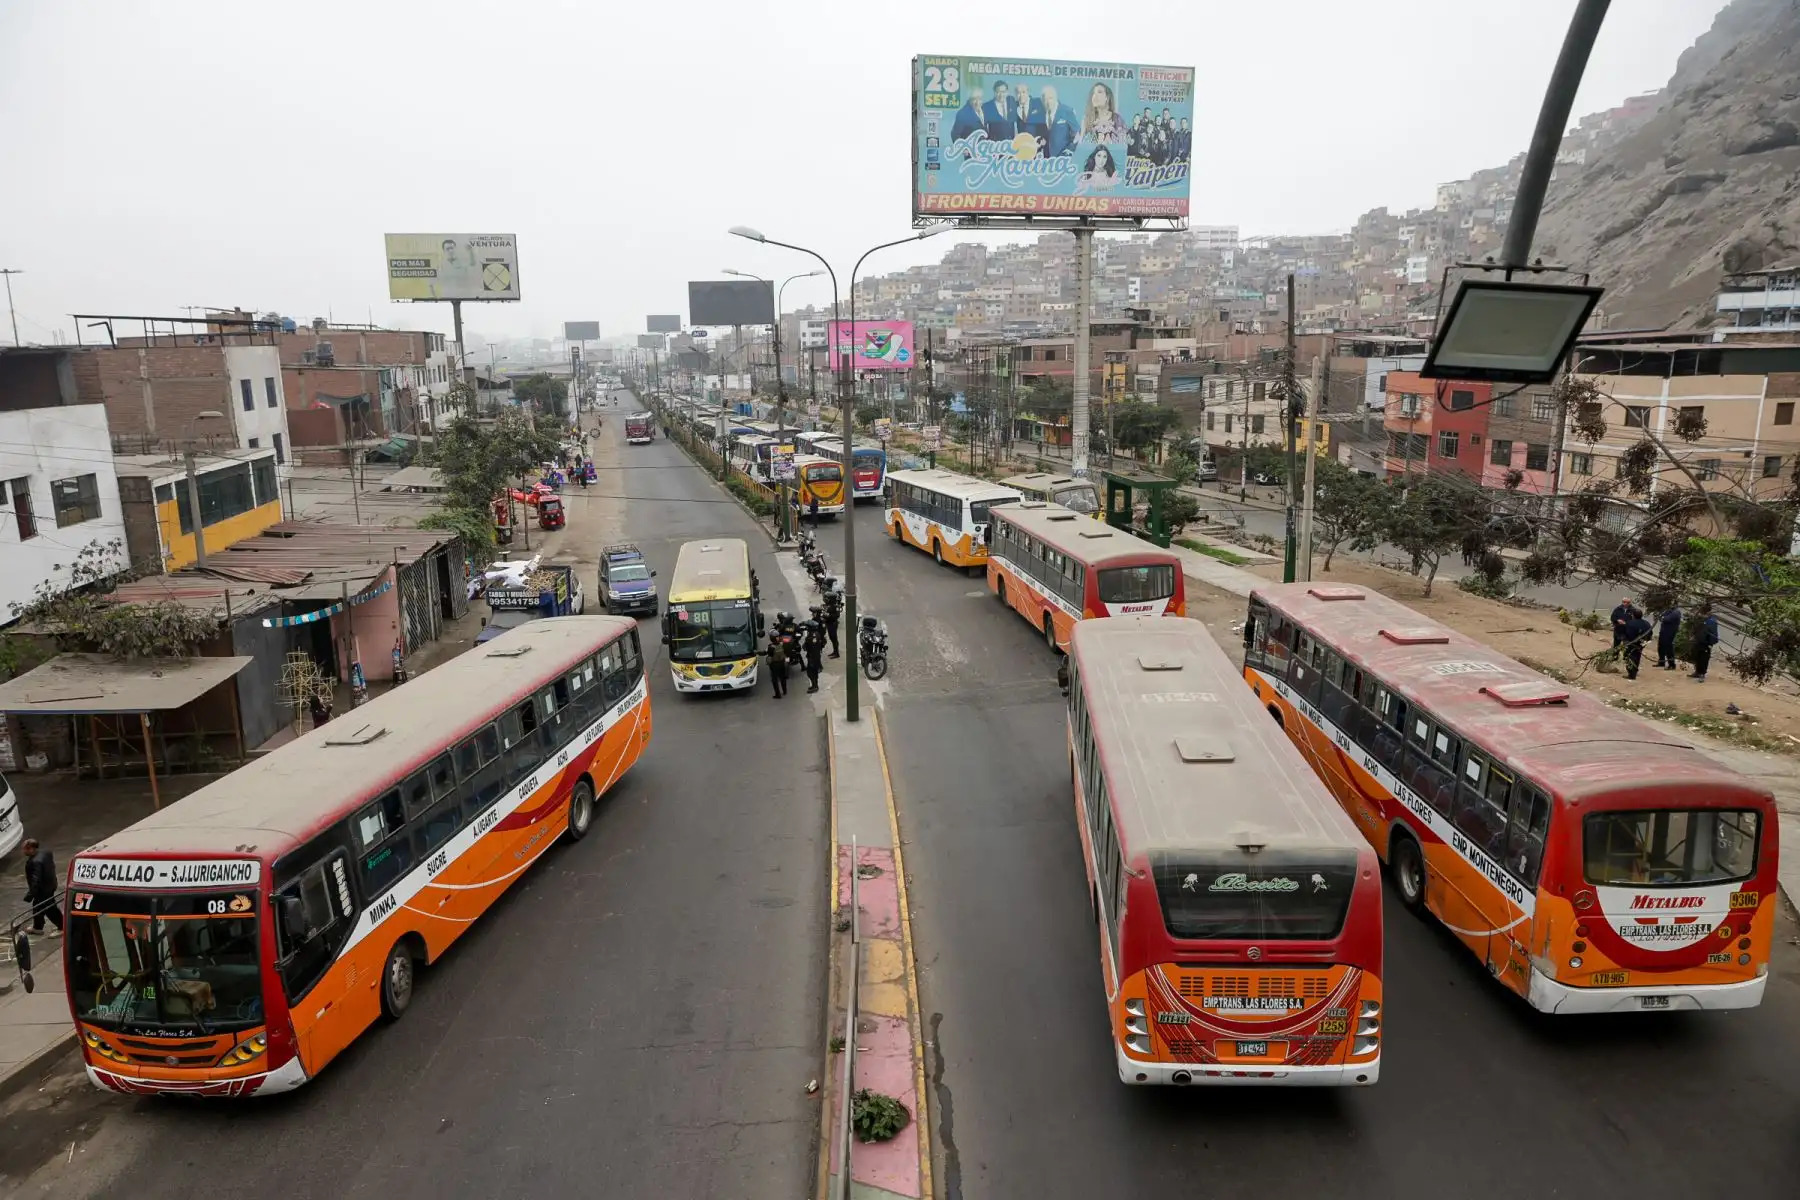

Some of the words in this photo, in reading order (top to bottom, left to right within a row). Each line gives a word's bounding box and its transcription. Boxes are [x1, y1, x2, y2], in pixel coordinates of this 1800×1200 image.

[968, 63, 1000, 73] MEGA
[1002, 64, 1052, 76] FESTIVAL
[1055, 66, 1068, 77] DE
[1069, 67, 1134, 79] PRIMAVERA
[1140, 71, 1187, 80] TELETICKET
[925, 67, 959, 92] 28
[944, 129, 1020, 161] Agua
[959, 152, 1076, 190] Marina
[926, 194, 1037, 209] FRONTERAS
[1042, 196, 1109, 211] UNIDAS
[1119, 205, 1179, 213] INDEPENDENCIA
[1300, 700, 1308, 714] SAN
[1308, 707, 1324, 730] MIGUEL
[1363, 757, 1379, 777] ACHO
[1394, 782, 1407, 802] LAS
[1407, 794, 1433, 825] FLORES
[1469, 847, 1523, 904] MONTENEGRO
[369, 893, 397, 925] MINKA
[426, 851, 447, 877] SUCRE
[518, 776, 539, 799] CAQUETA
[557, 750, 568, 768] ACHO
[77, 863, 97, 878] 1258
[99, 863, 155, 882] CALLAO
[1208, 873, 1299, 892] Rosita
[74, 893, 94, 910] 57
[207, 900, 226, 914] 08
[1630, 895, 1706, 909] METALBUS
[1731, 894, 1757, 907] 9306
[1658, 925, 1672, 935] LAS
[1673, 925, 1696, 935] FLORES
[1709, 954, 1731, 962] TVE-26
[1245, 998, 1260, 1009] LAS
[1261, 998, 1288, 1009] FLORES
[1289, 999, 1303, 1009] S.A.
[1319, 1021, 1344, 1031] 1258
